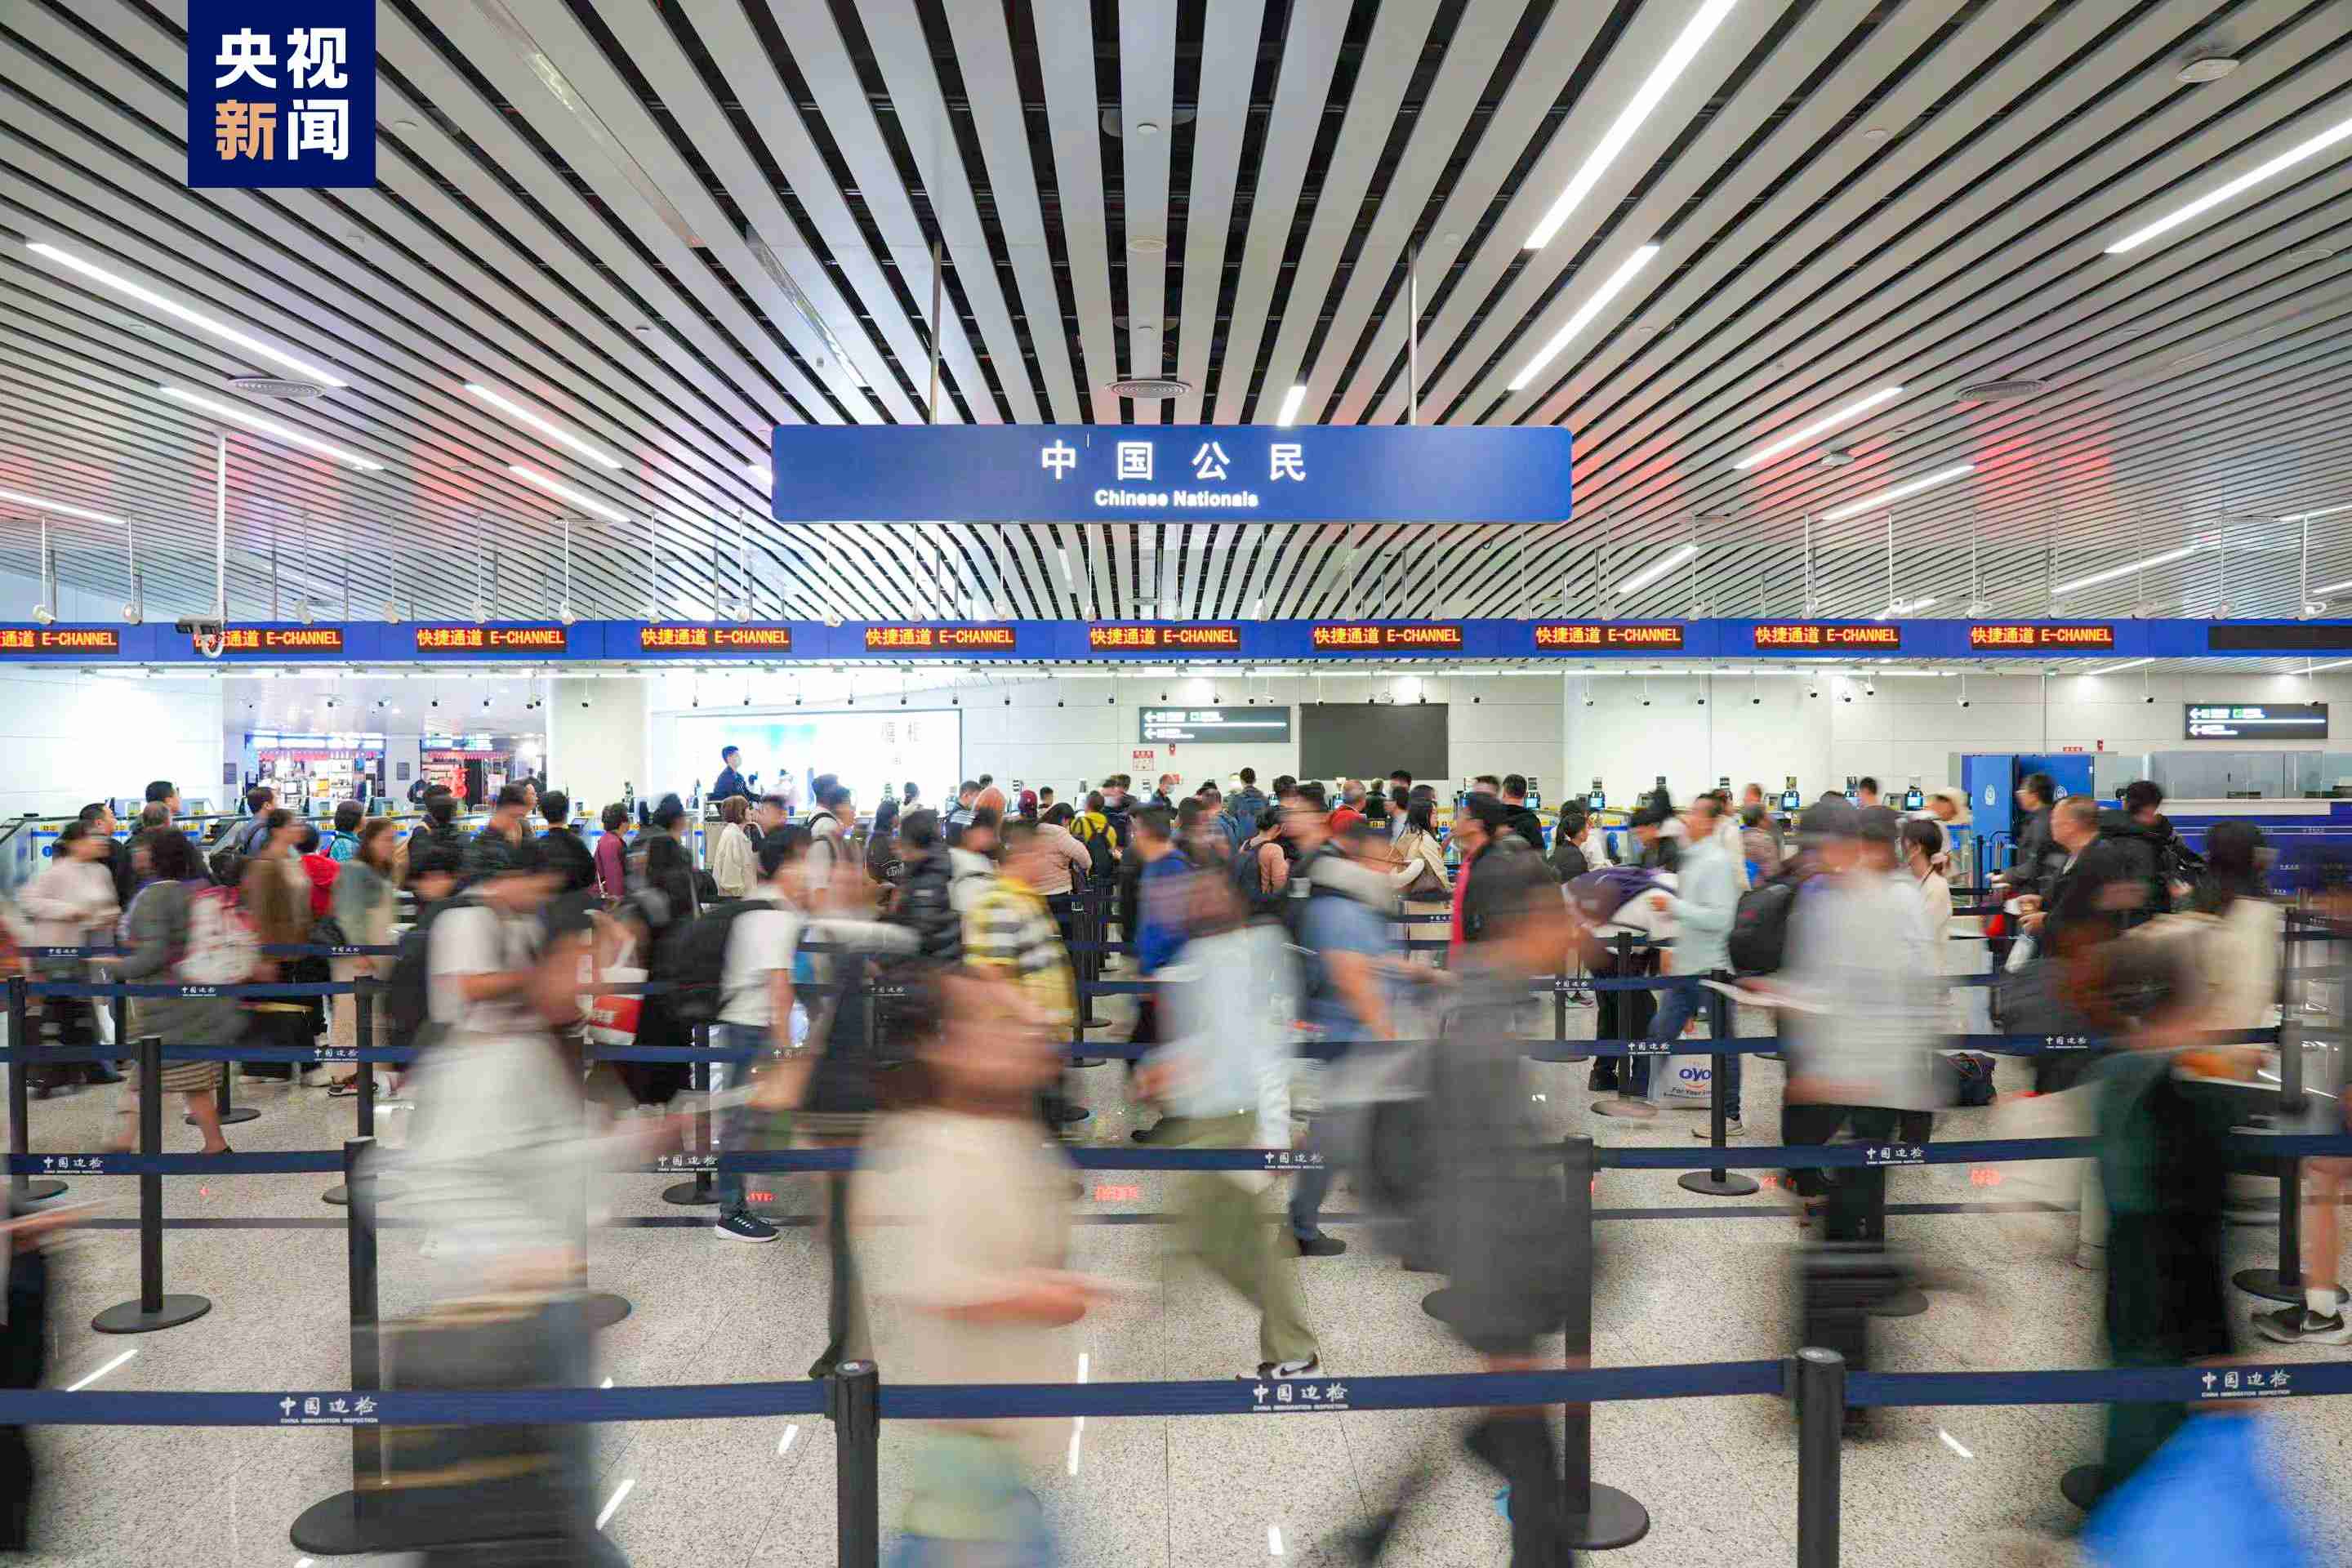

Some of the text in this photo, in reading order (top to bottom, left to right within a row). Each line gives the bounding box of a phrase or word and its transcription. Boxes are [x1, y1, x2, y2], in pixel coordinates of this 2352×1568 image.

[1041, 439, 1306, 481] 中国公民
[1094, 489, 1258, 507] Chinese Nationals
[1, 630, 118, 648] 通道 E-CHANNEL
[194, 630, 341, 648] 通道 E-CHANNEL
[417, 629, 564, 646] 快捷通道 E-CHANNEL
[641, 628, 789, 646] 快捷通道 E-CHANNEL
[866, 628, 1013, 645] 快捷通道 E-CHANNEL
[1090, 627, 1237, 645] 快捷通道 E-CHANNEL
[1313, 627, 1460, 644] 快捷通道 E-CHANNEL
[1535, 627, 1681, 644] 快捷通道 E-CHANNEL
[1755, 627, 1898, 644] 快捷通道 E-CHANNEL
[1971, 627, 2112, 644] 快捷通道 E-CHANNEL
[657, 1155, 718, 1167] 中国边检
[1265, 1151, 1324, 1165] 中国边检
[1866, 1147, 1925, 1160] 中国边检
[43, 1156, 104, 1169] 中国边检
[2202, 1369, 2291, 1390] 中国边检
[1253, 1382, 1348, 1404] 中国边检
[279, 1396, 378, 1416] 中国边检
